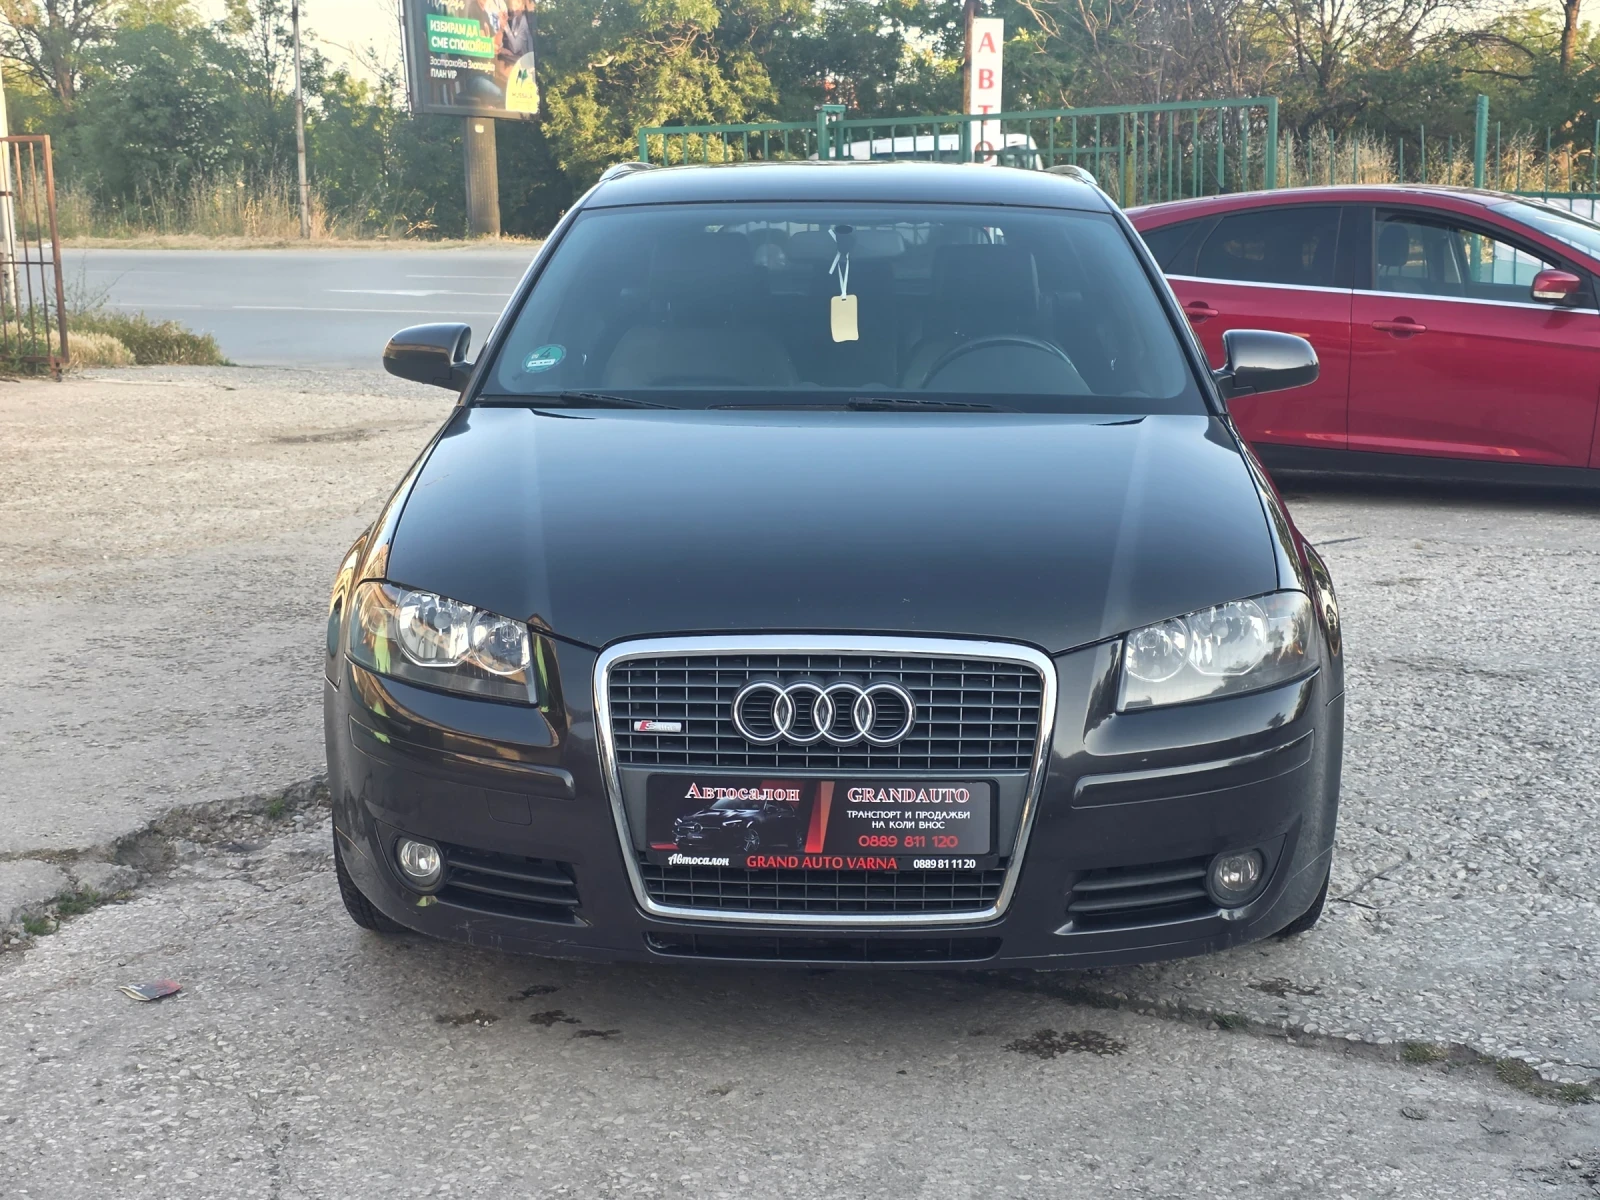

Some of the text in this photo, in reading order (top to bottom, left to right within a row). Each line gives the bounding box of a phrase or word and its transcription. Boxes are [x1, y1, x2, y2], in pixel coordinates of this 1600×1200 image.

[430, 20, 478, 38] ИЗБИРАМ ДА
[431, 36, 491, 53] СМЕ СПОКОЙНИ
[430, 68, 458, 79] ПЛАН VIP
[684, 782, 800, 801] Автосалон
[847, 787, 970, 803] GRANDAUTO
[846, 810, 971, 820] ТРАНСПОРТ И ПРОДАЖБИ
[872, 820, 946, 829] НА КОЛИ ВНОС
[858, 835, 958, 848] 0889 811 120
[668, 853, 730, 866] Автосалон
[746, 855, 897, 869] GRAND AUTO VARNA
